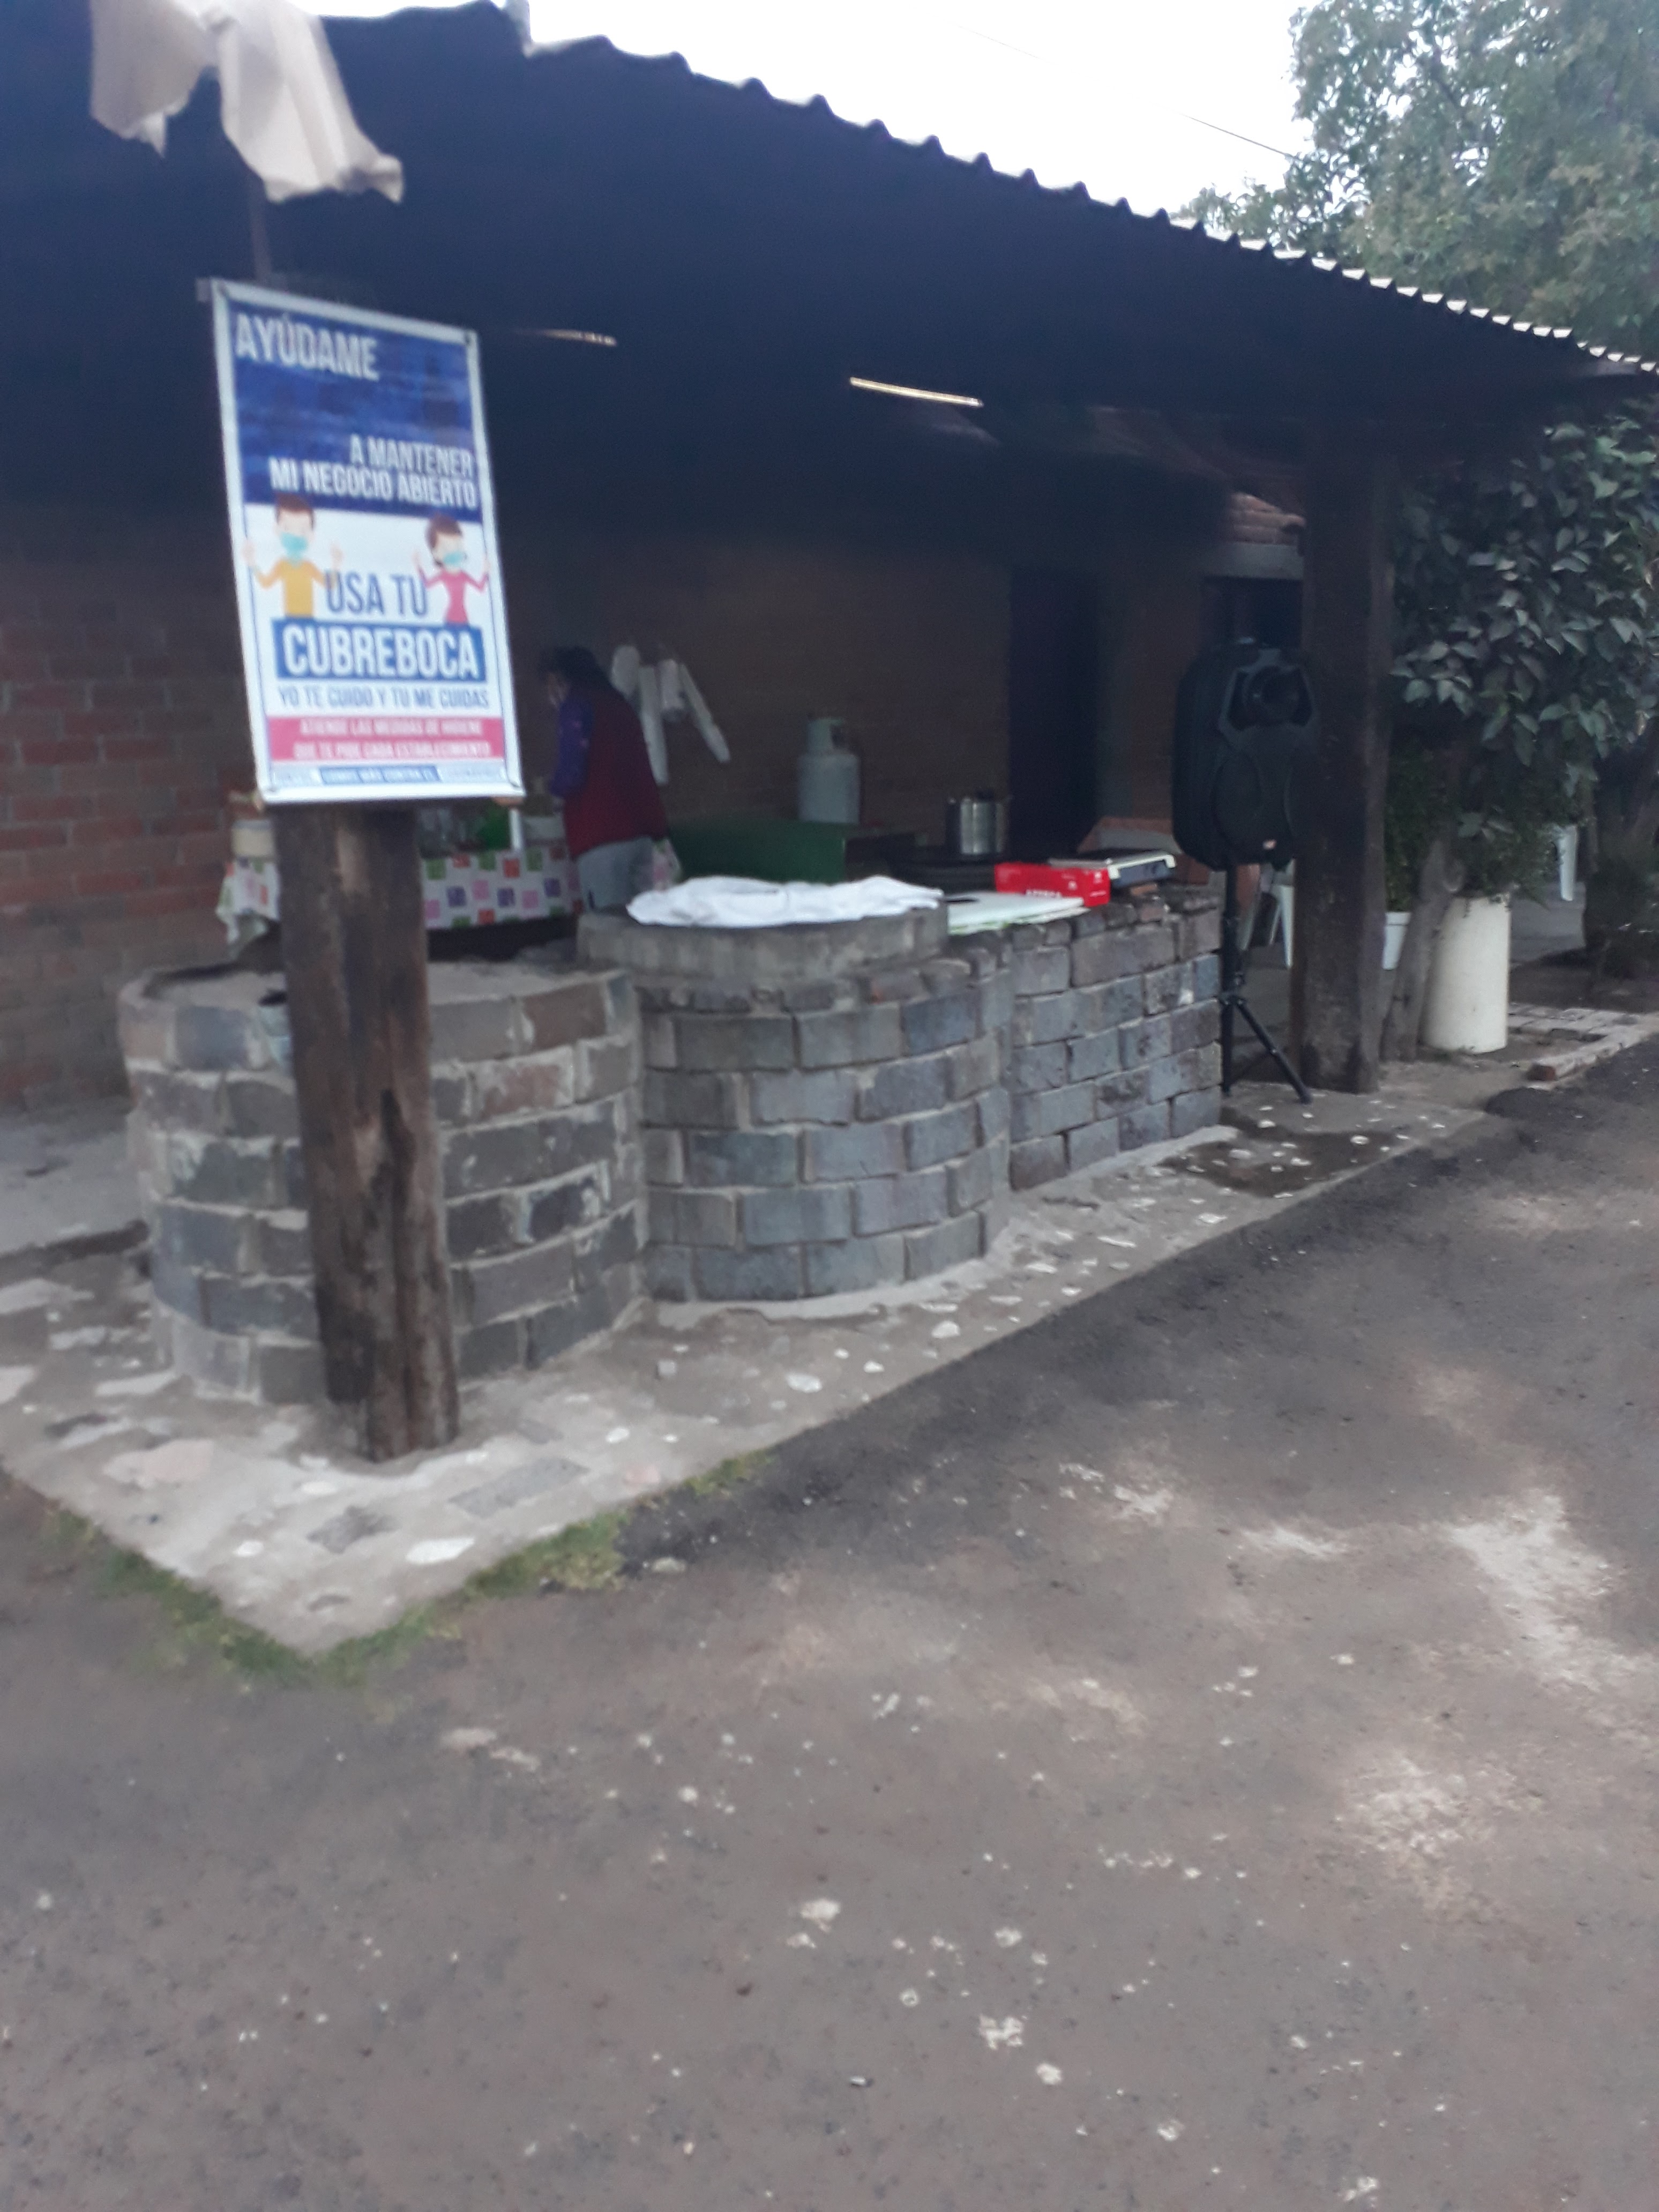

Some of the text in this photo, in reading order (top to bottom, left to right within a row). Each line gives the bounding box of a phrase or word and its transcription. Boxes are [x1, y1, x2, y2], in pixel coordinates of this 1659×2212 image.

[350, 433, 474, 479] A MANTENER
[270, 457, 477, 511] MI NEGOCIO ABIERTO
[325, 570, 428, 616] USA TU
[282, 624, 479, 679] CUBREBOCA
[278, 685, 490, 709] YO TE CUIDO Y TU ME CUIDAS
